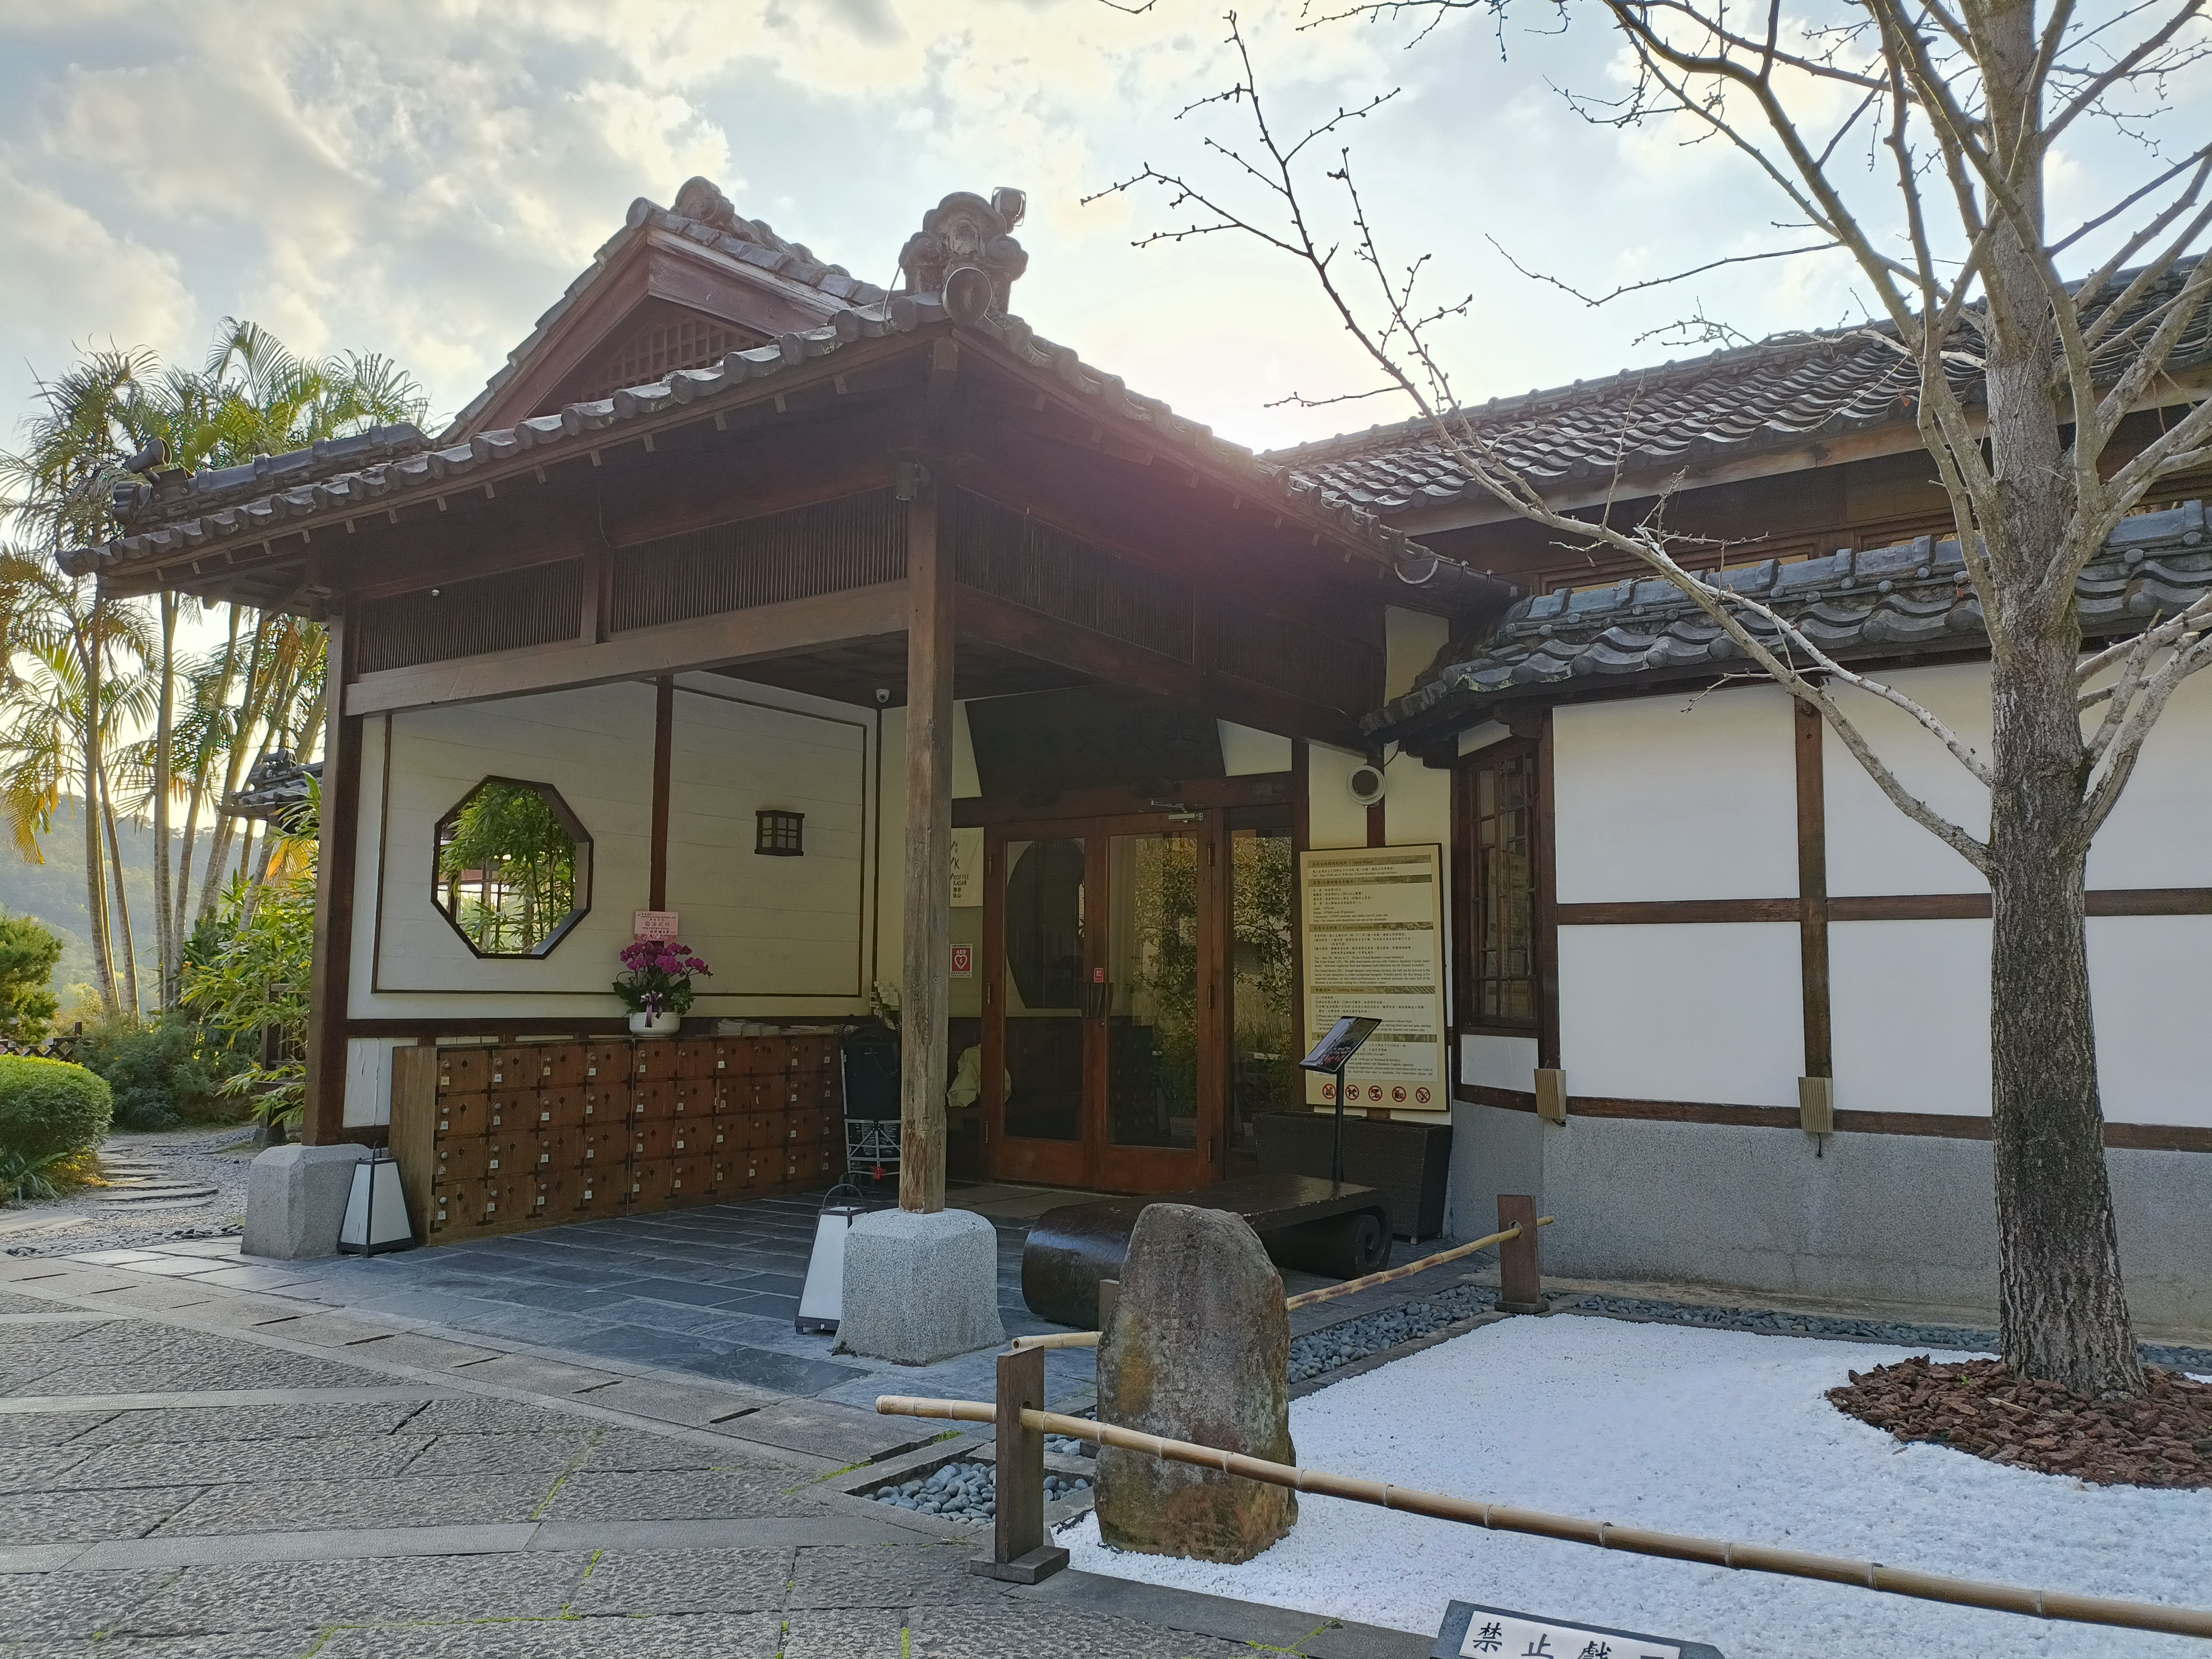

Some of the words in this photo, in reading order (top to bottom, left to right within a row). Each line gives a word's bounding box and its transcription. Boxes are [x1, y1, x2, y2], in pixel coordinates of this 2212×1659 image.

[954, 858, 960, 870] K
[1472, 1622, 1664, 1659] 禁止戲
